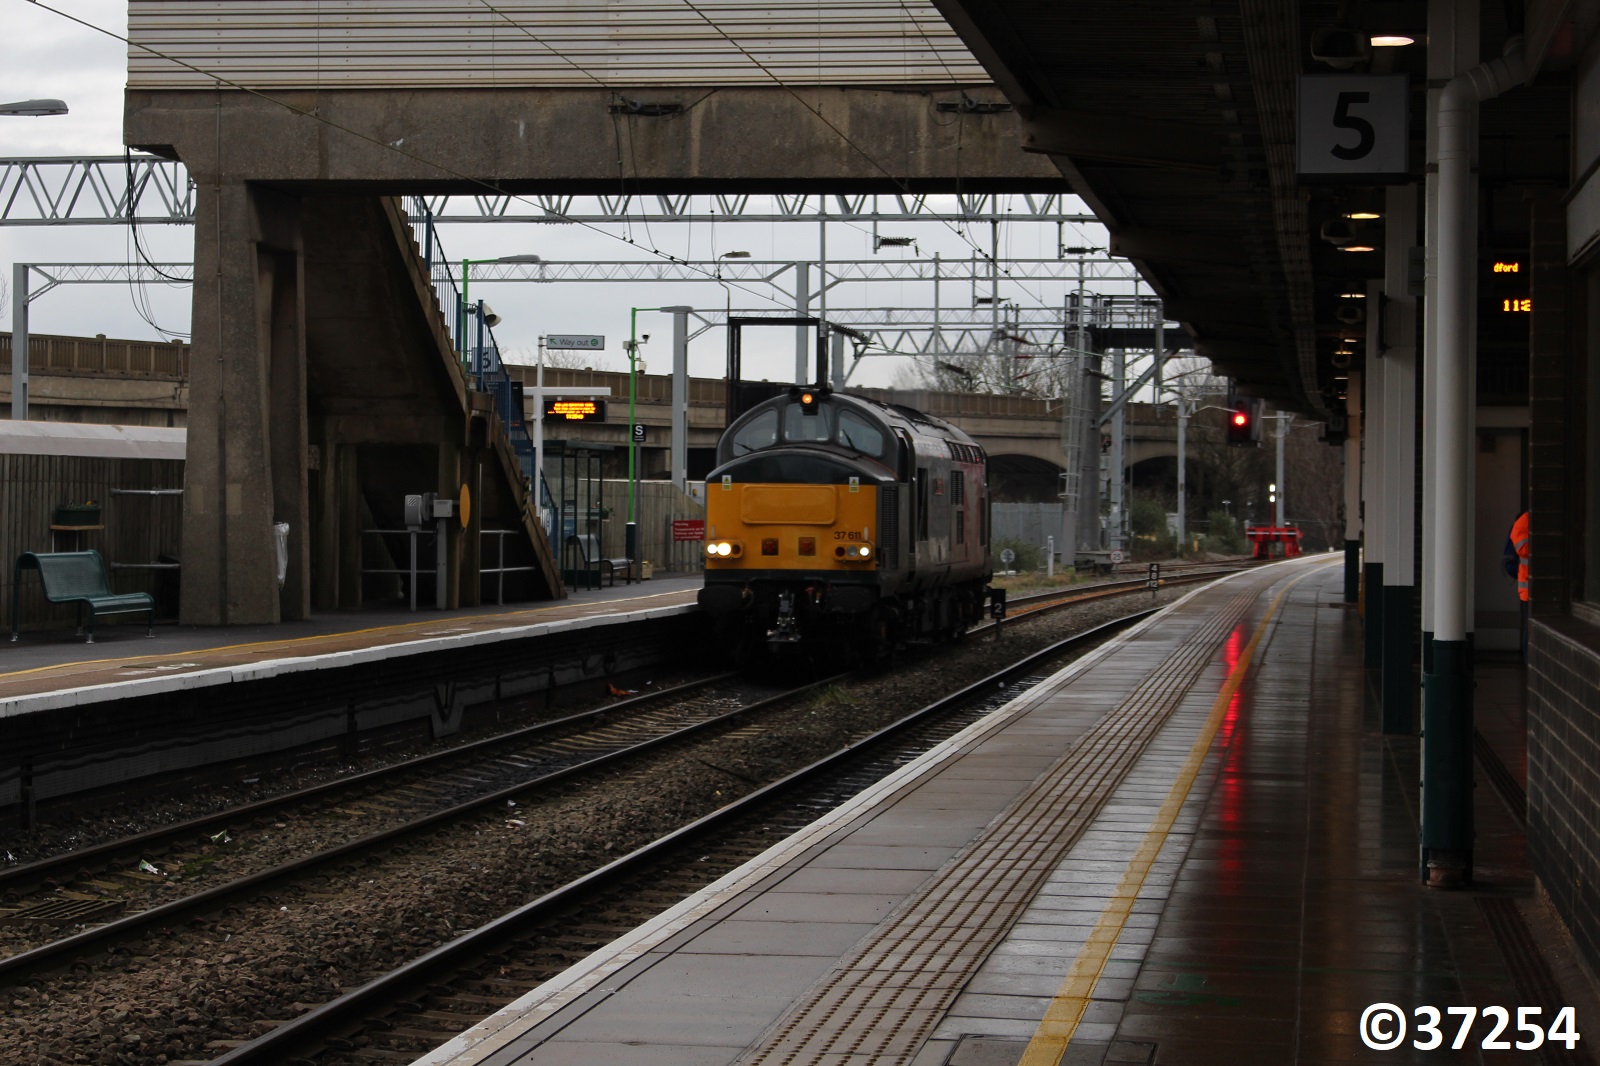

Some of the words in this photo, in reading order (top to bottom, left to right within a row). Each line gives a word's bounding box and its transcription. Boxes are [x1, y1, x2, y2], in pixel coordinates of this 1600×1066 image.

[1330, 91, 1376, 160] 5
[559, 338, 575, 347] Way
[577, 339, 590, 347] out
[634, 425, 645, 436] S
[834, 531, 846, 540] 37
[848, 531, 861, 540] 611
[994, 602, 1003, 613] 2
